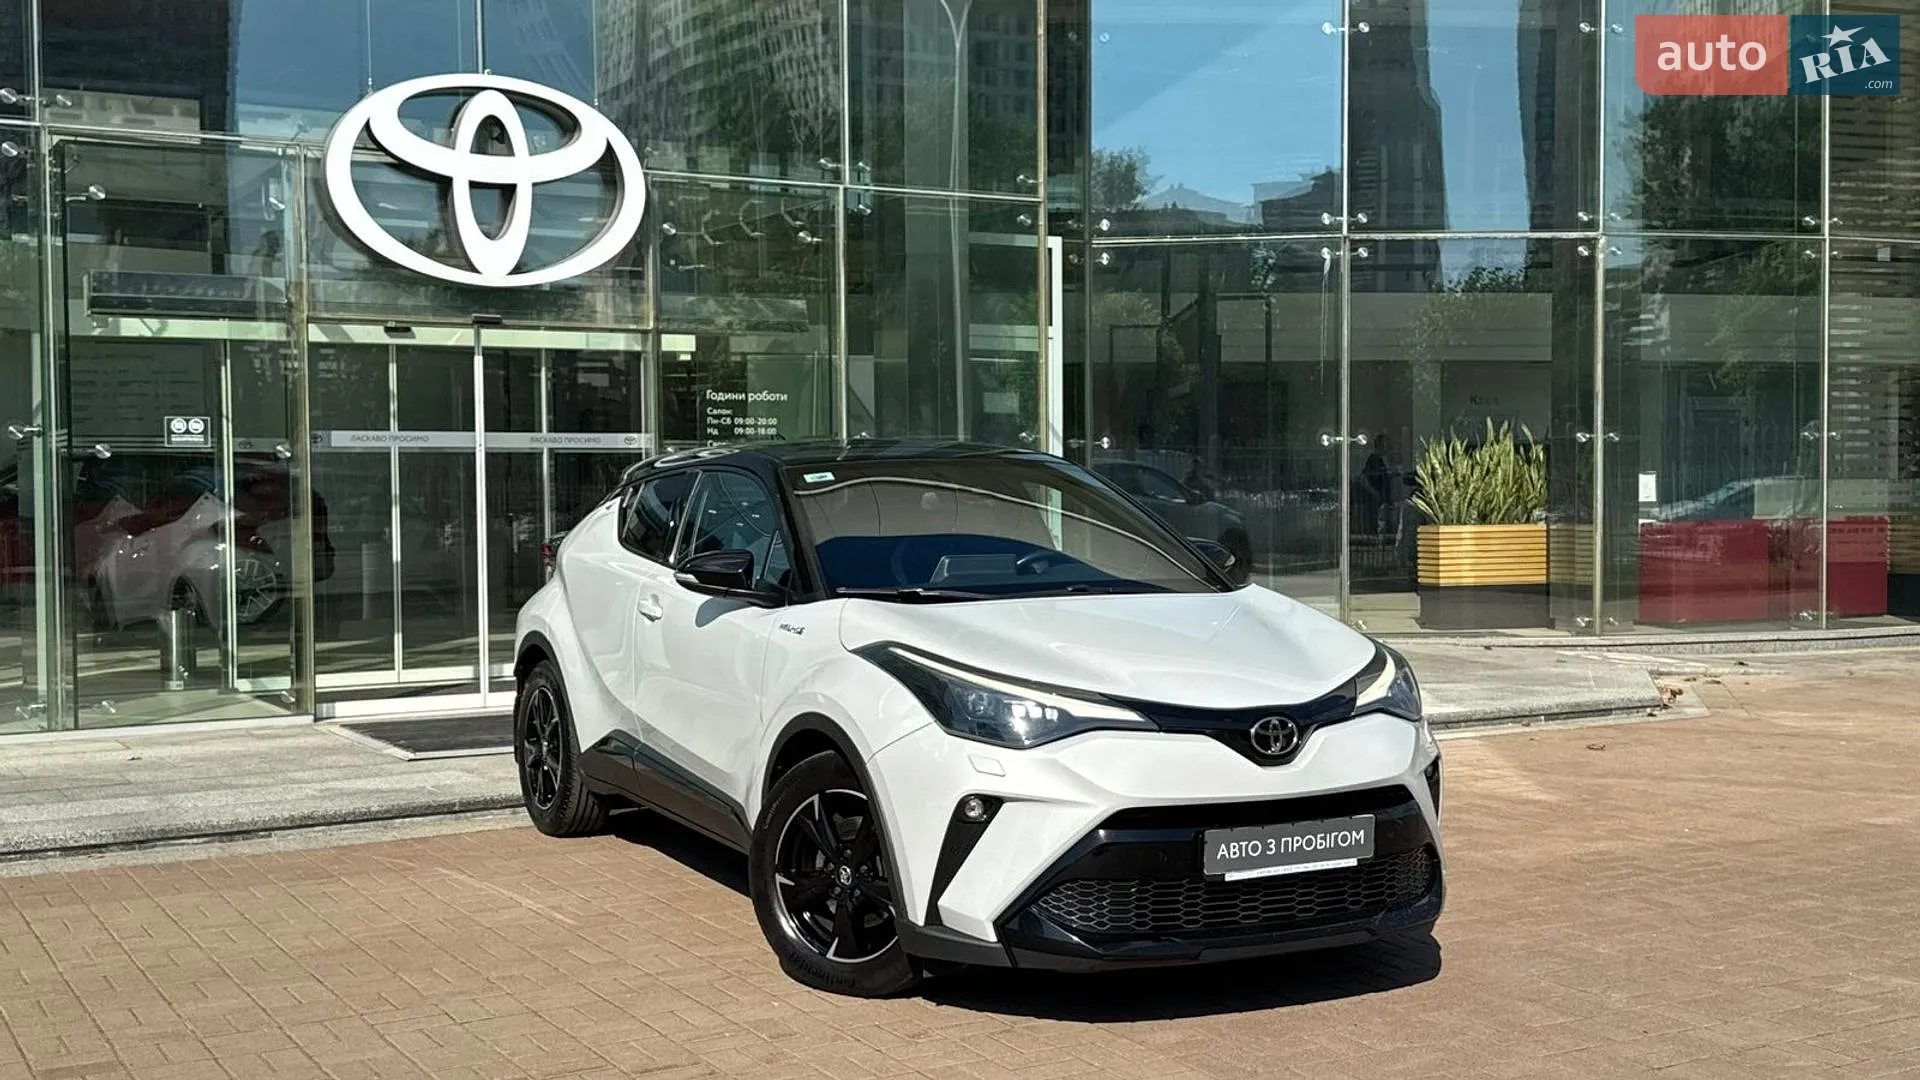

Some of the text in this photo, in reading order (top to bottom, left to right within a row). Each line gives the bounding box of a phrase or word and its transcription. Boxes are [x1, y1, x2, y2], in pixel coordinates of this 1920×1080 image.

[706, 389, 788, 403] Години роботи
[706, 416, 732, 425] Пн-Сб
[351, 434, 387, 442] ЛАСКАВО
[1216, 840, 1262, 860] АВТО
[1280, 829, 1365, 853] ПРОБІГОМ
